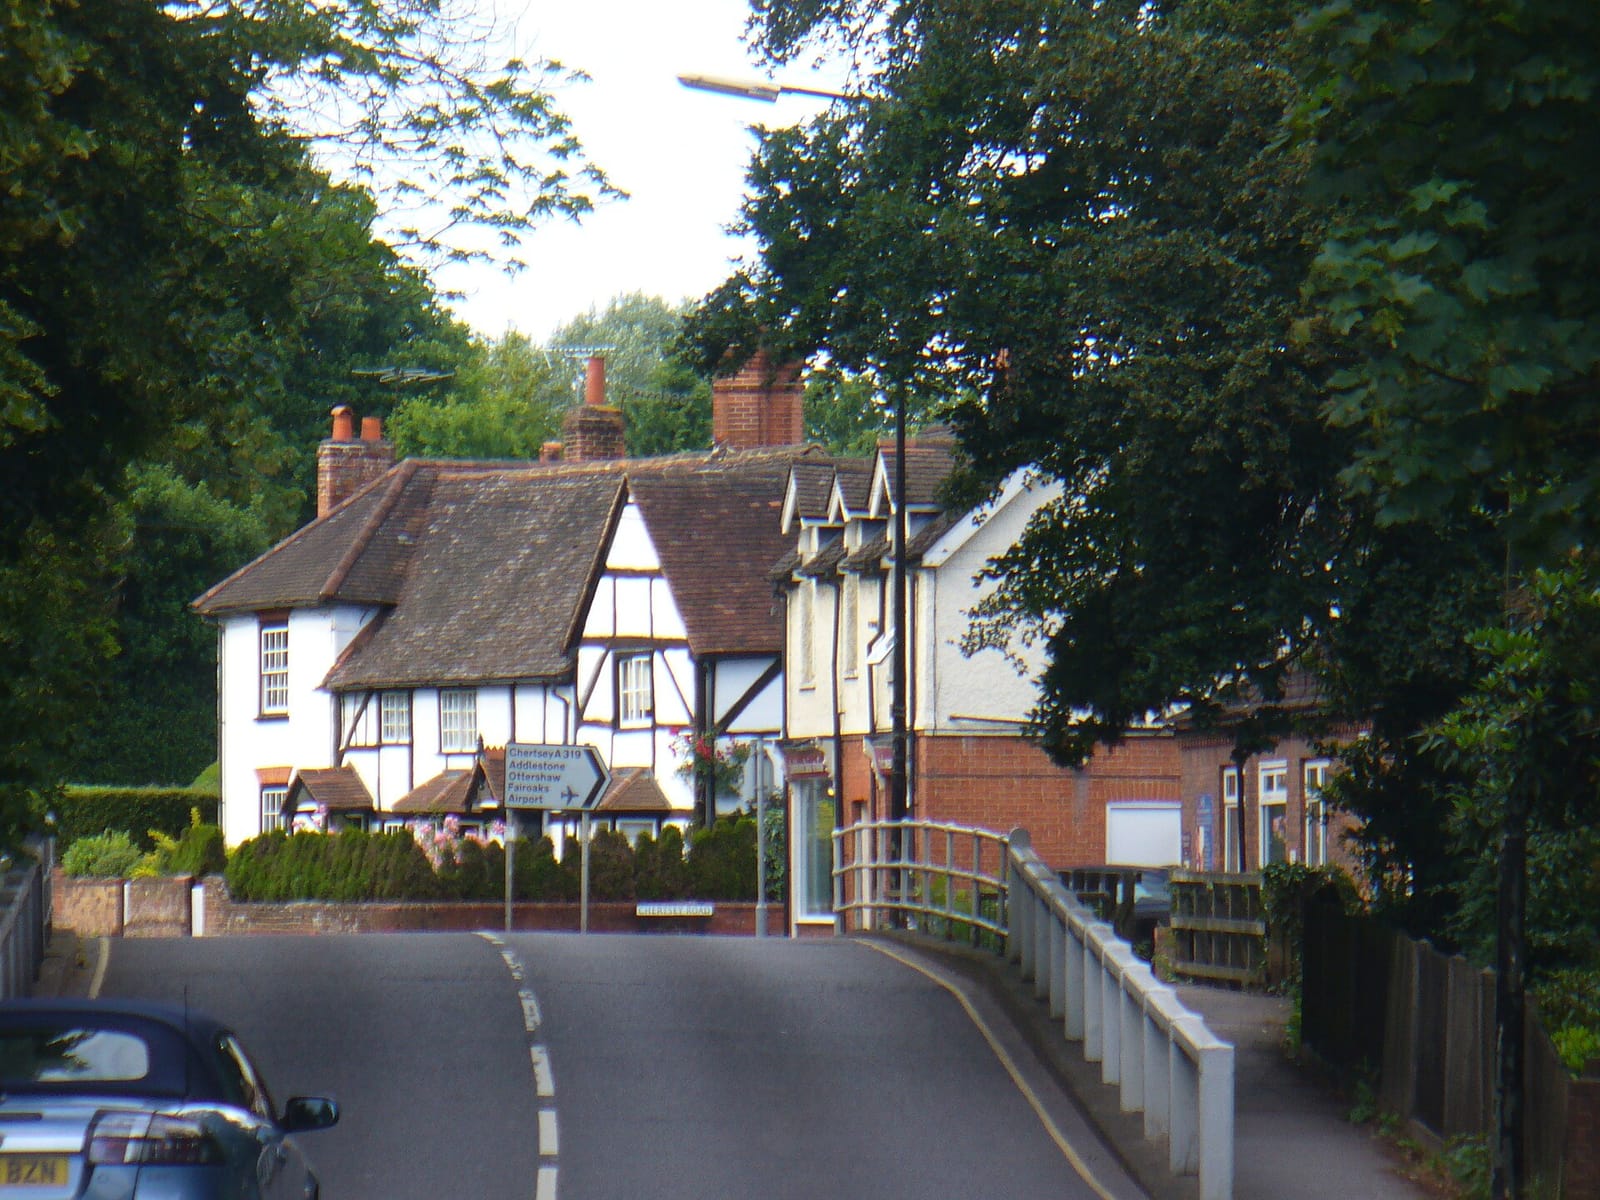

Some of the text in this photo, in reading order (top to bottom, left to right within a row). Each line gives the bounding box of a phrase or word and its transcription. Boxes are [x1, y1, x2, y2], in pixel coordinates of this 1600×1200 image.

[509, 748, 556, 760] Chertsey
[509, 760, 566, 771] Addlestone
[508, 772, 561, 782] Ottershaw
[508, 783, 549, 793] Fairoaks
[508, 794, 543, 804] Airport
[686, 905, 711, 915] ROAD
[7, 1159, 56, 1185] BZN
